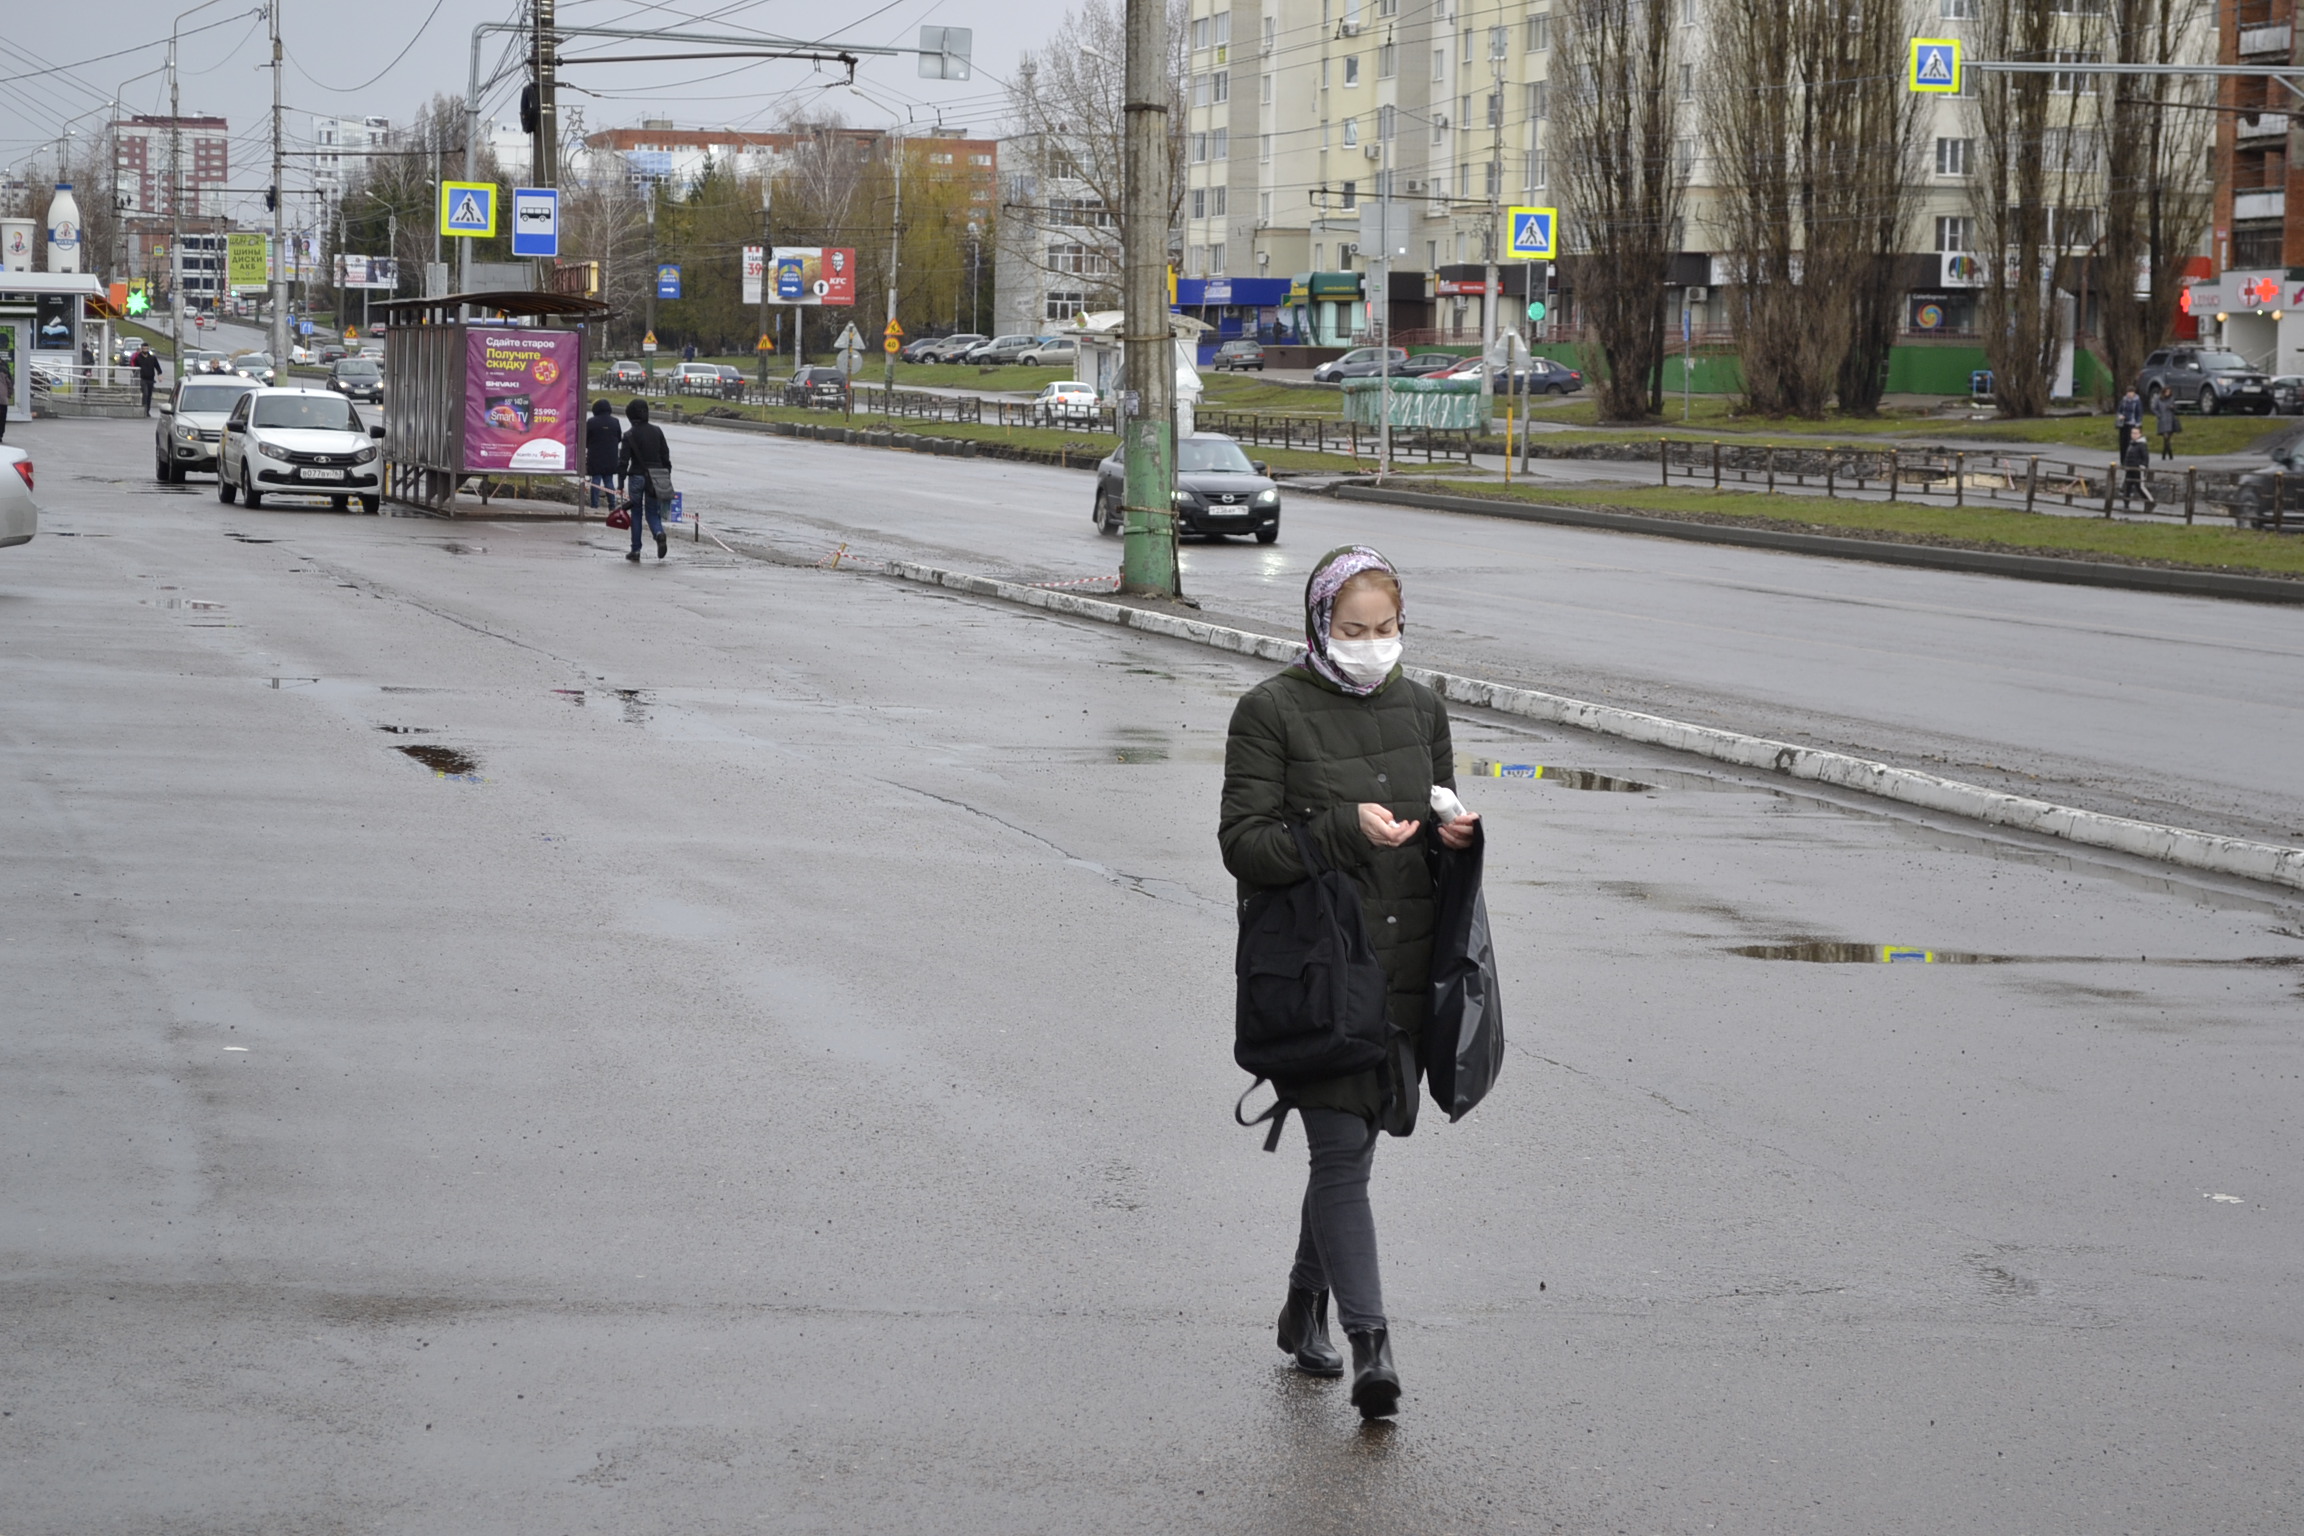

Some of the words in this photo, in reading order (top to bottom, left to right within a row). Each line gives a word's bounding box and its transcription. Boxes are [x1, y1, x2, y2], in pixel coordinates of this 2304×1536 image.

[485, 337, 520, 347] Сдайте
[522, 340, 555, 349] старое
[886, 341, 896, 349] 40
[486, 348, 541, 361] Получите
[485, 359, 527, 371] скидку
[490, 411, 515, 422] Smart
[517, 411, 528, 423] TV
